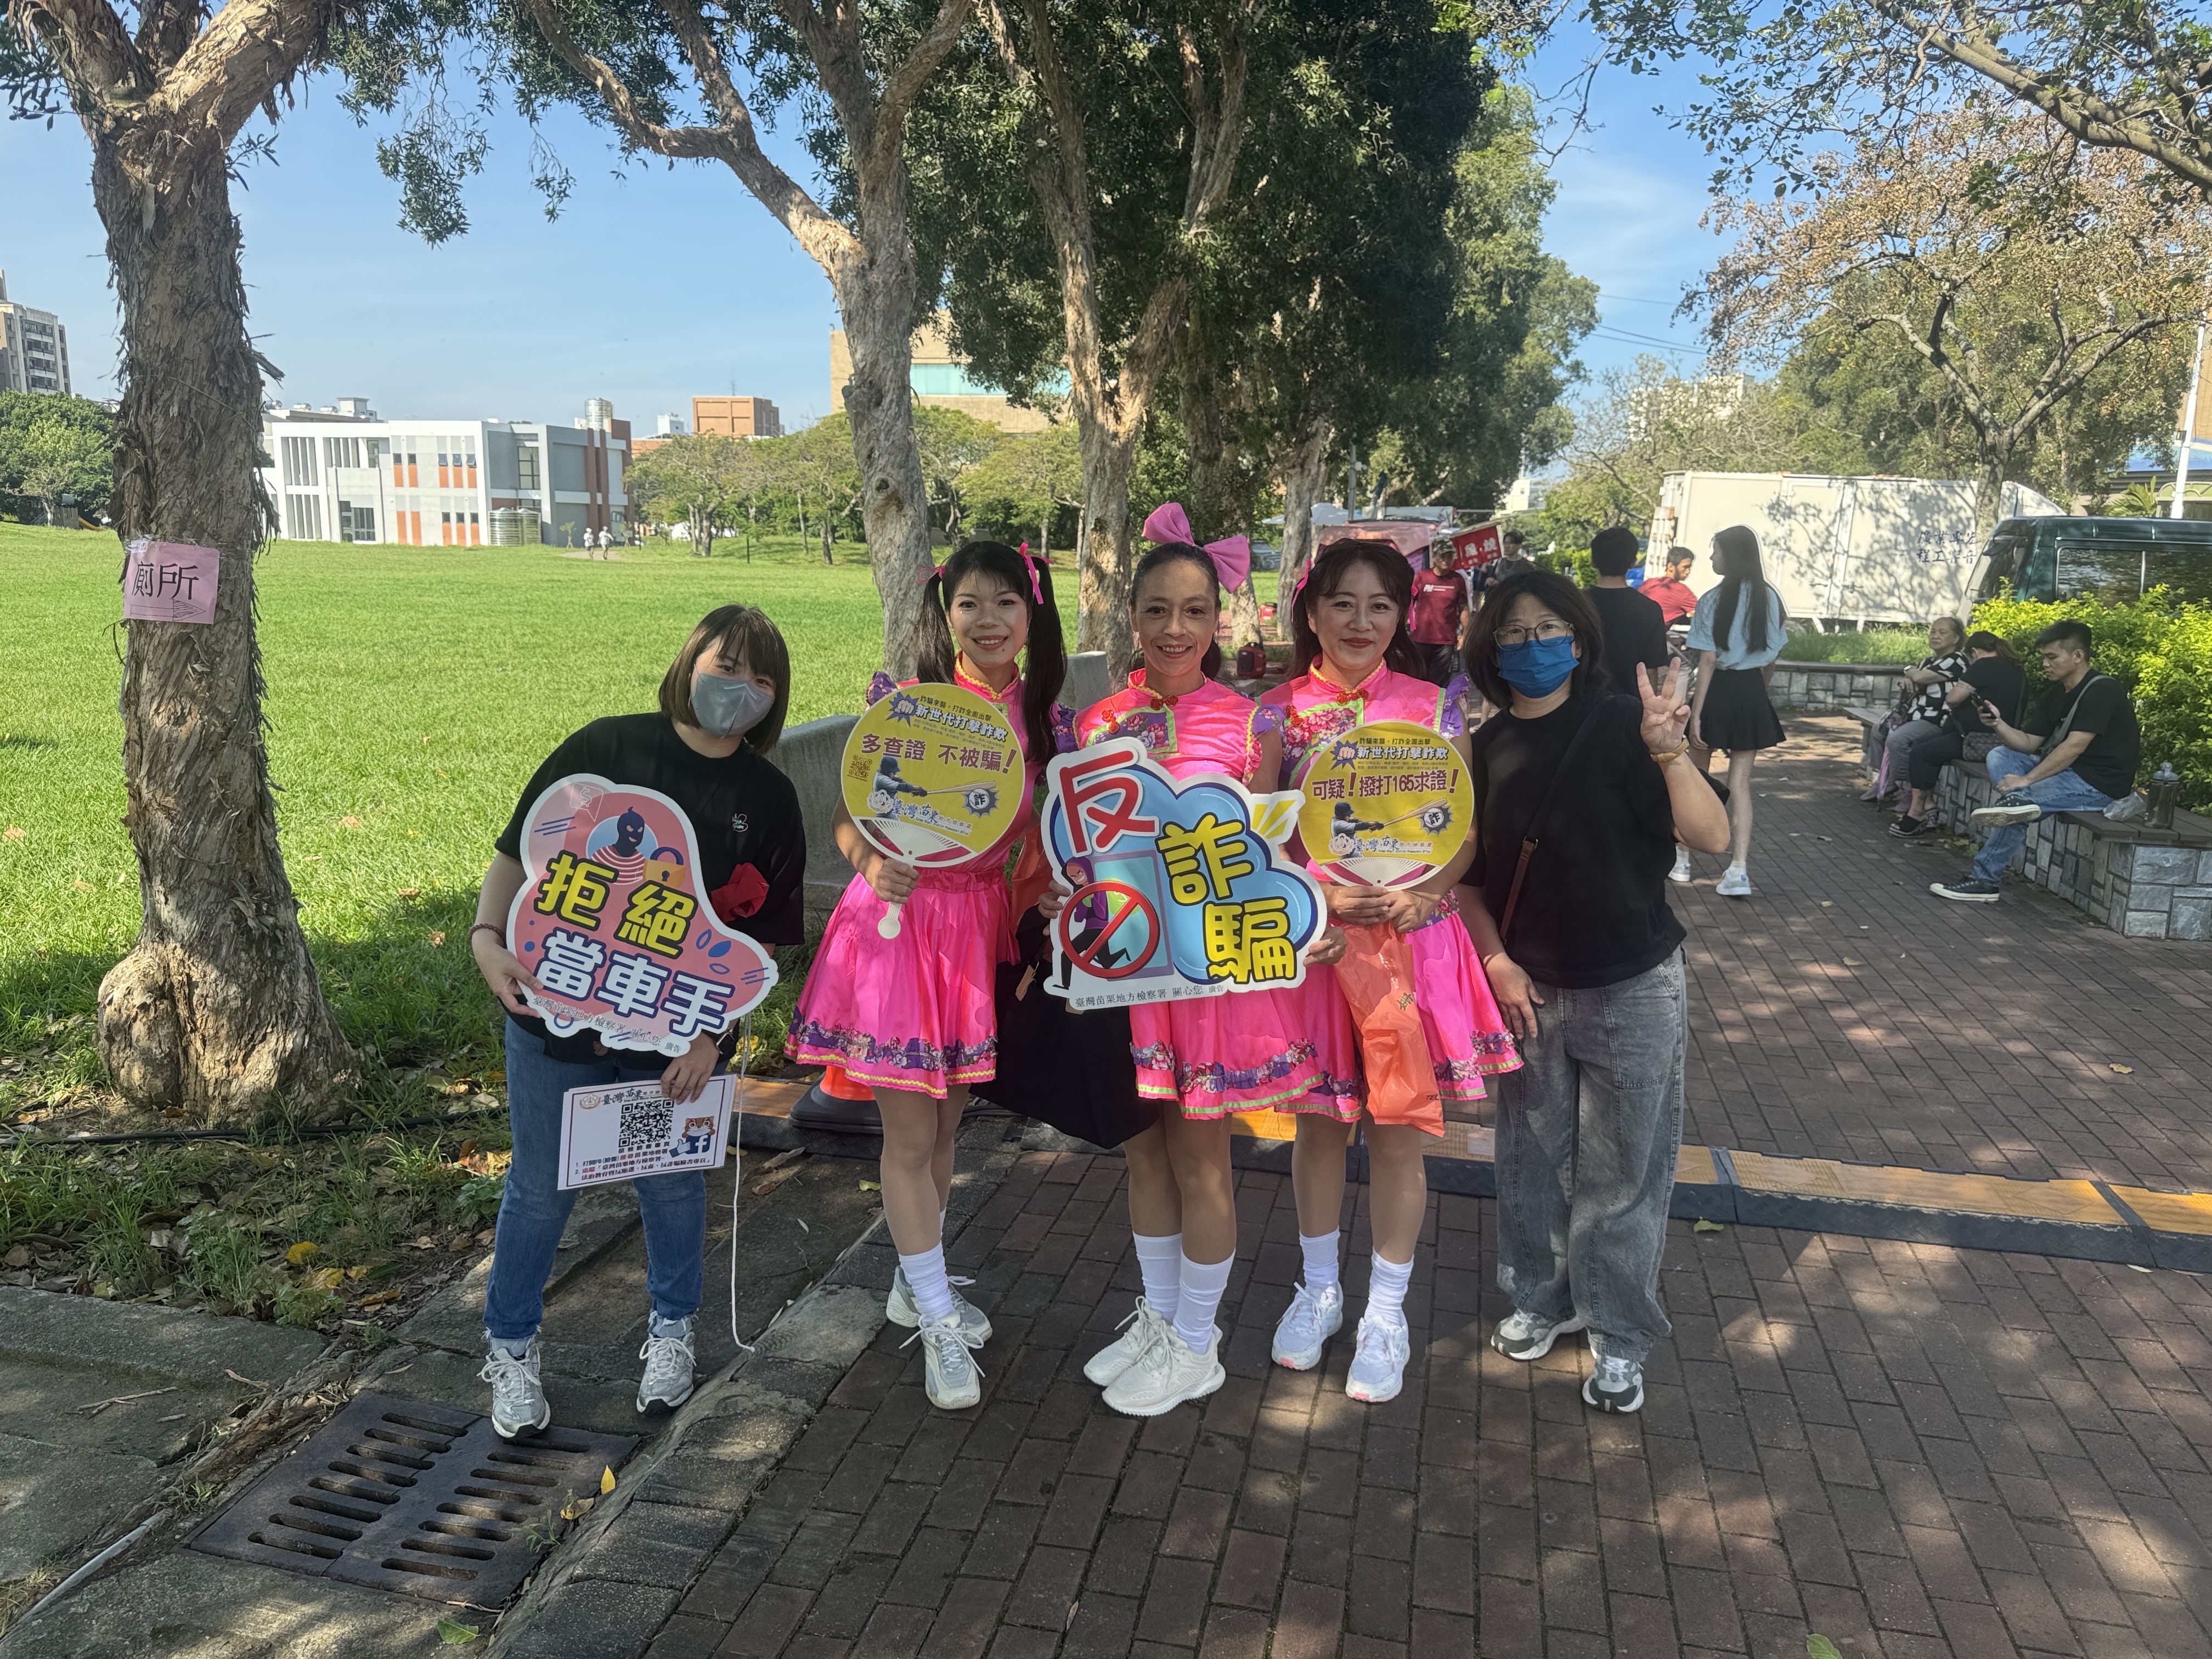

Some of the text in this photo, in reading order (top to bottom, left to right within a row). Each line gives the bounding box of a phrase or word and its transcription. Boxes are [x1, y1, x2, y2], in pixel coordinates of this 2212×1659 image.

[131, 560, 200, 600] 廁所
[915, 704, 1008, 742] 新世代打擊詐欺
[861, 733, 927, 761] 多查證
[1357, 746, 1449, 760] 新世代打擊詐欺
[974, 794, 986, 806] 詐
[534, 850, 698, 959] 拒絕
[535, 927, 735, 1036] 當車手
